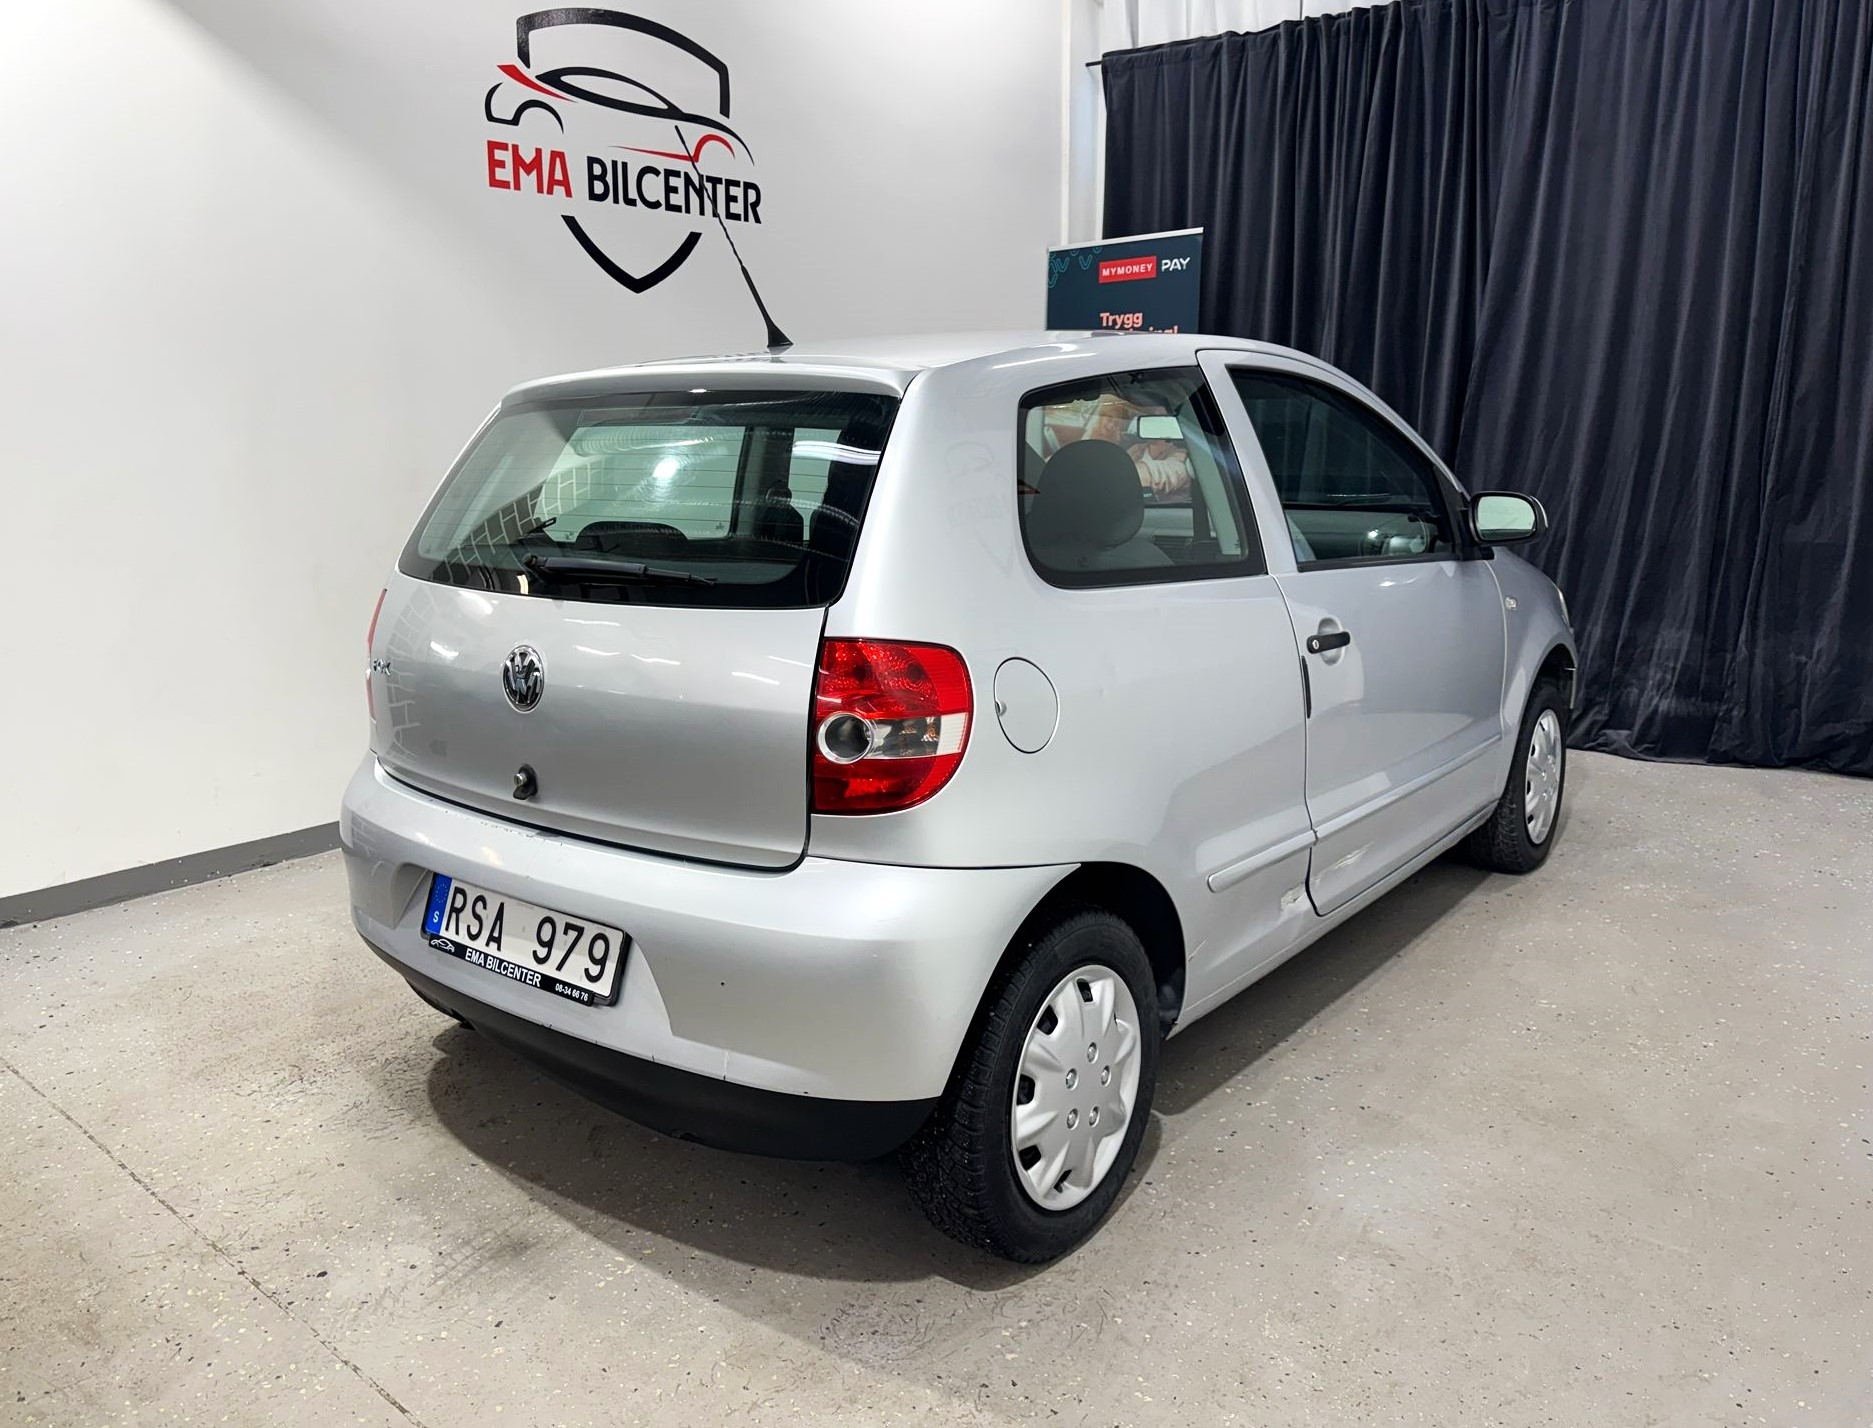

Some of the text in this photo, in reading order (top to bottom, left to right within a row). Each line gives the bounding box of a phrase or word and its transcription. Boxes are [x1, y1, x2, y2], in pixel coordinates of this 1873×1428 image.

[487, 140, 762, 224] EMA BILCENTER
[1102, 256, 1191, 276] MYMONEY PAY
[1100, 312, 1143, 329] Trygg
[432, 911, 440, 923] S
[444, 886, 610, 983] RSA 979
[465, 948, 542, 987] EMA BILCENTER
